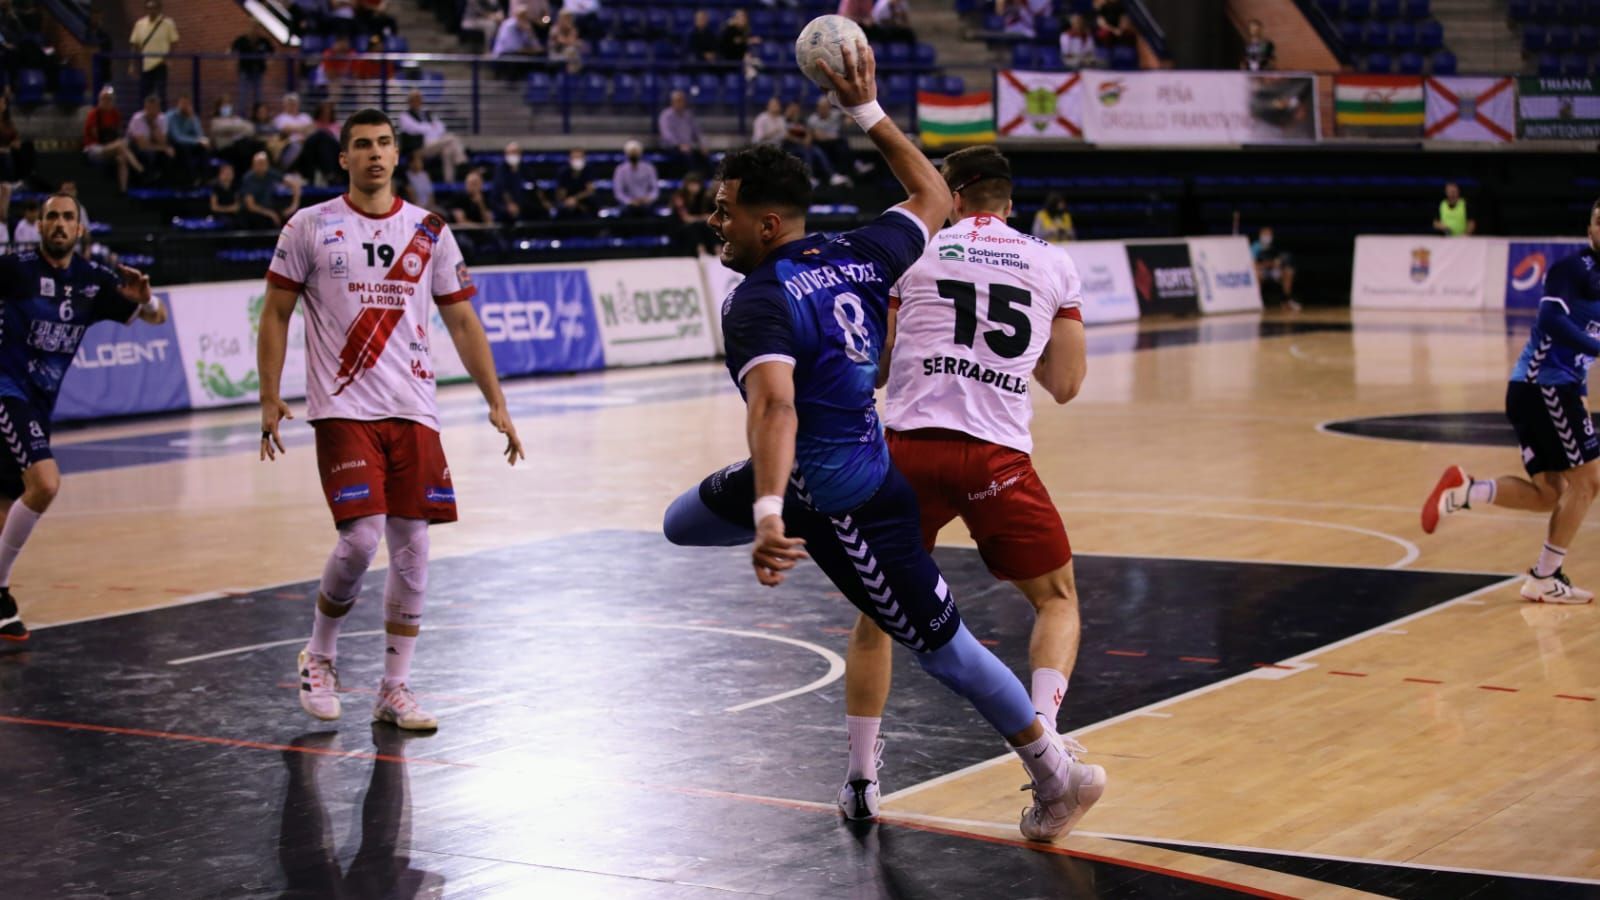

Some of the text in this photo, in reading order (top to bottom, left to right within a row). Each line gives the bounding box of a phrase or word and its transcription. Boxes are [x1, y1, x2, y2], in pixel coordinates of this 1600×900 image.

[362, 242, 395, 268] 19
[968, 247, 1020, 259] Gobierno
[968, 256, 1030, 270] de La Rioja
[348, 282, 366, 293] BM
[58, 300, 74, 321] 6
[360, 294, 407, 306] LA RIOJA
[833, 291, 871, 364] 8
[936, 279, 1032, 359] 15
[923, 356, 1028, 395] SERRADILL
